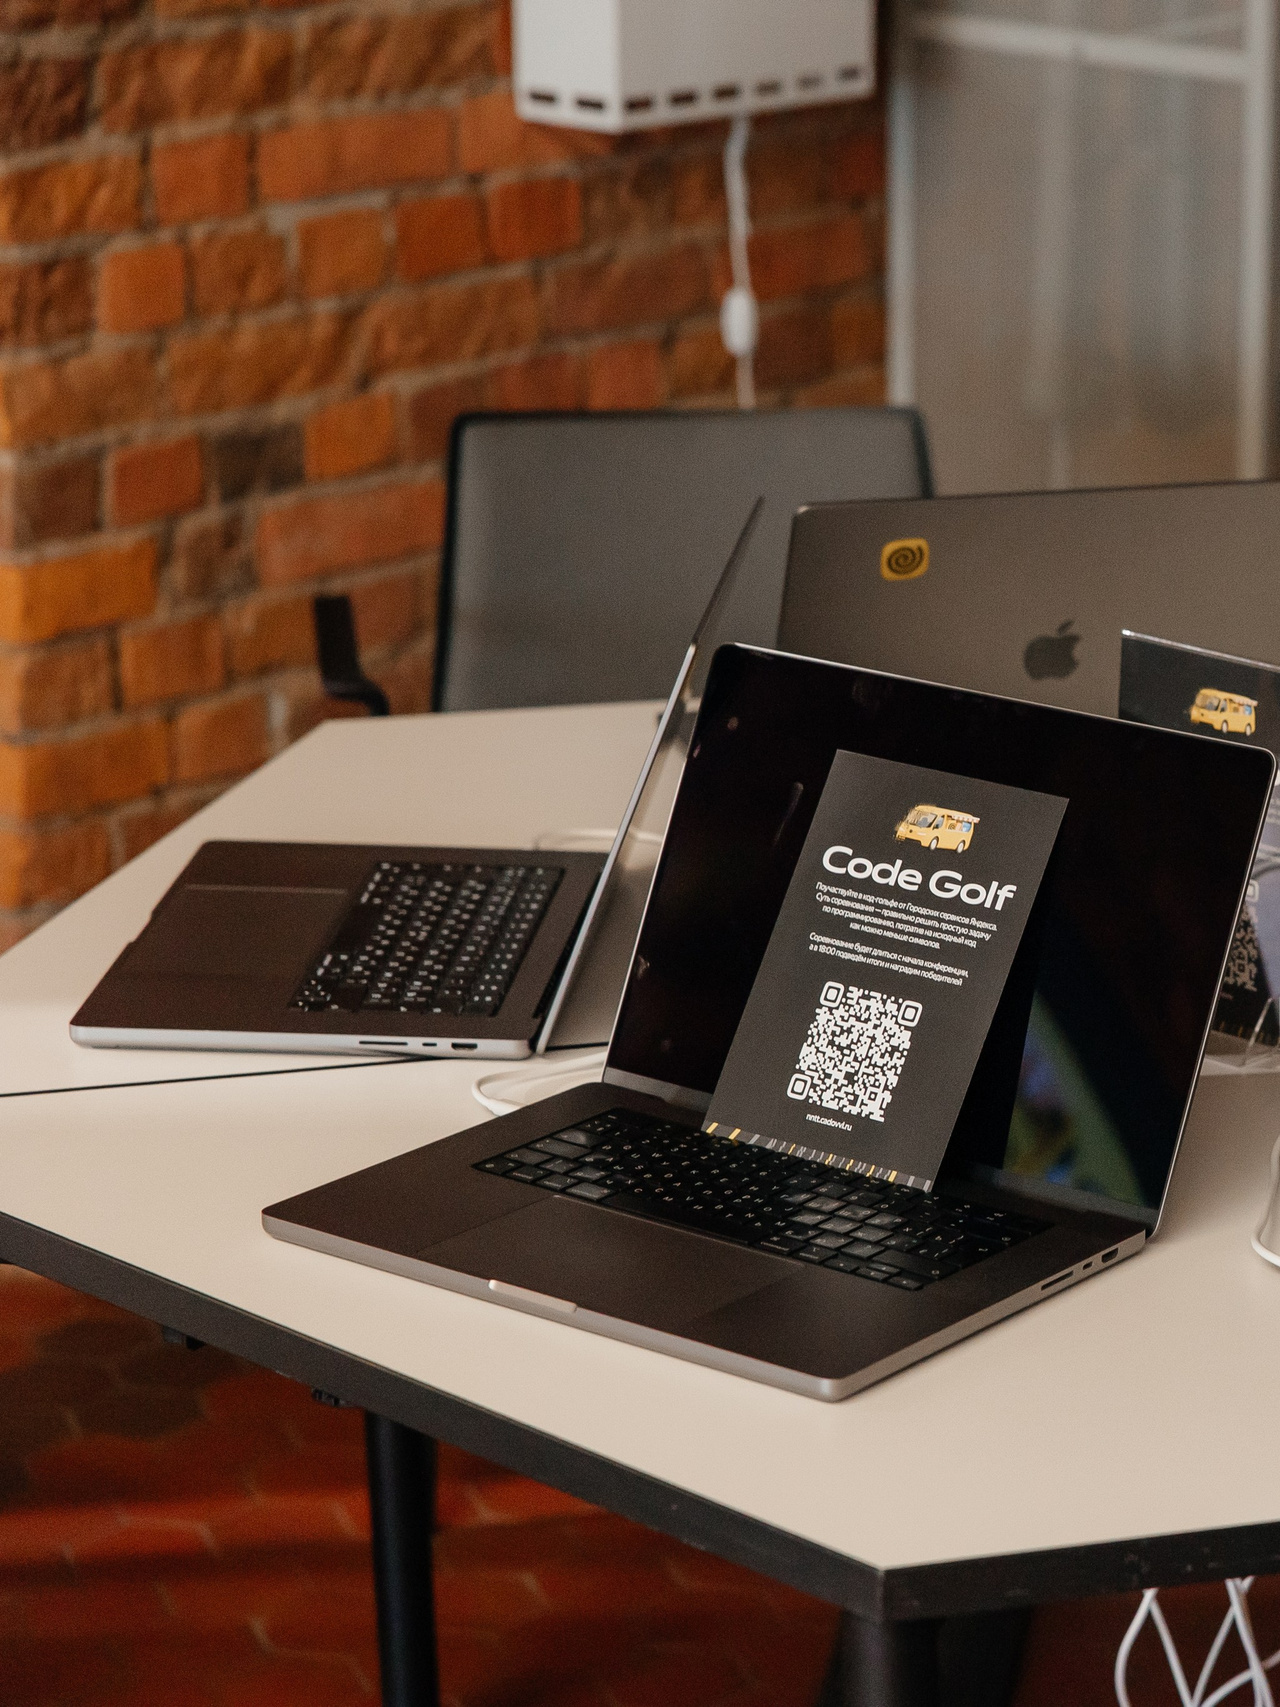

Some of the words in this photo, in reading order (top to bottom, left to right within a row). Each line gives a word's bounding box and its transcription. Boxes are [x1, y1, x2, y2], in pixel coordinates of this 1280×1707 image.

[822, 846, 923, 891] Code
[929, 870, 1017, 911] Golf
[816, 882, 858, 898] Поучаствуйте
[906, 902, 940, 917] Городских
[940, 912, 970, 924] сервисов
[816, 892, 831, 902] Суть
[831, 897, 875, 912] соревнования
[881, 909, 915, 922] правильно
[914, 917, 939, 928] решить
[940, 922, 969, 934] простую
[968, 929, 991, 941] задачу
[822, 905, 831, 913] по
[895, 922, 924, 935] потратив
[924, 929, 933, 937] на
[933, 931, 964, 944] исходный
[964, 939, 977, 948] код
[850, 922, 861, 930] как
[861, 925, 883, 935] можно
[883, 930, 909, 941] меньше
[810, 932, 854, 949] Соревнование
[854, 943, 873, 954] будет
[871, 948, 898, 960] длиться
[902, 956, 924, 966] начала
[819, 944, 836, 955] 18:00
[866, 958, 885, 967] итоги
[890, 963, 921, 976] наградим
[920, 970, 963, 986] победителей
